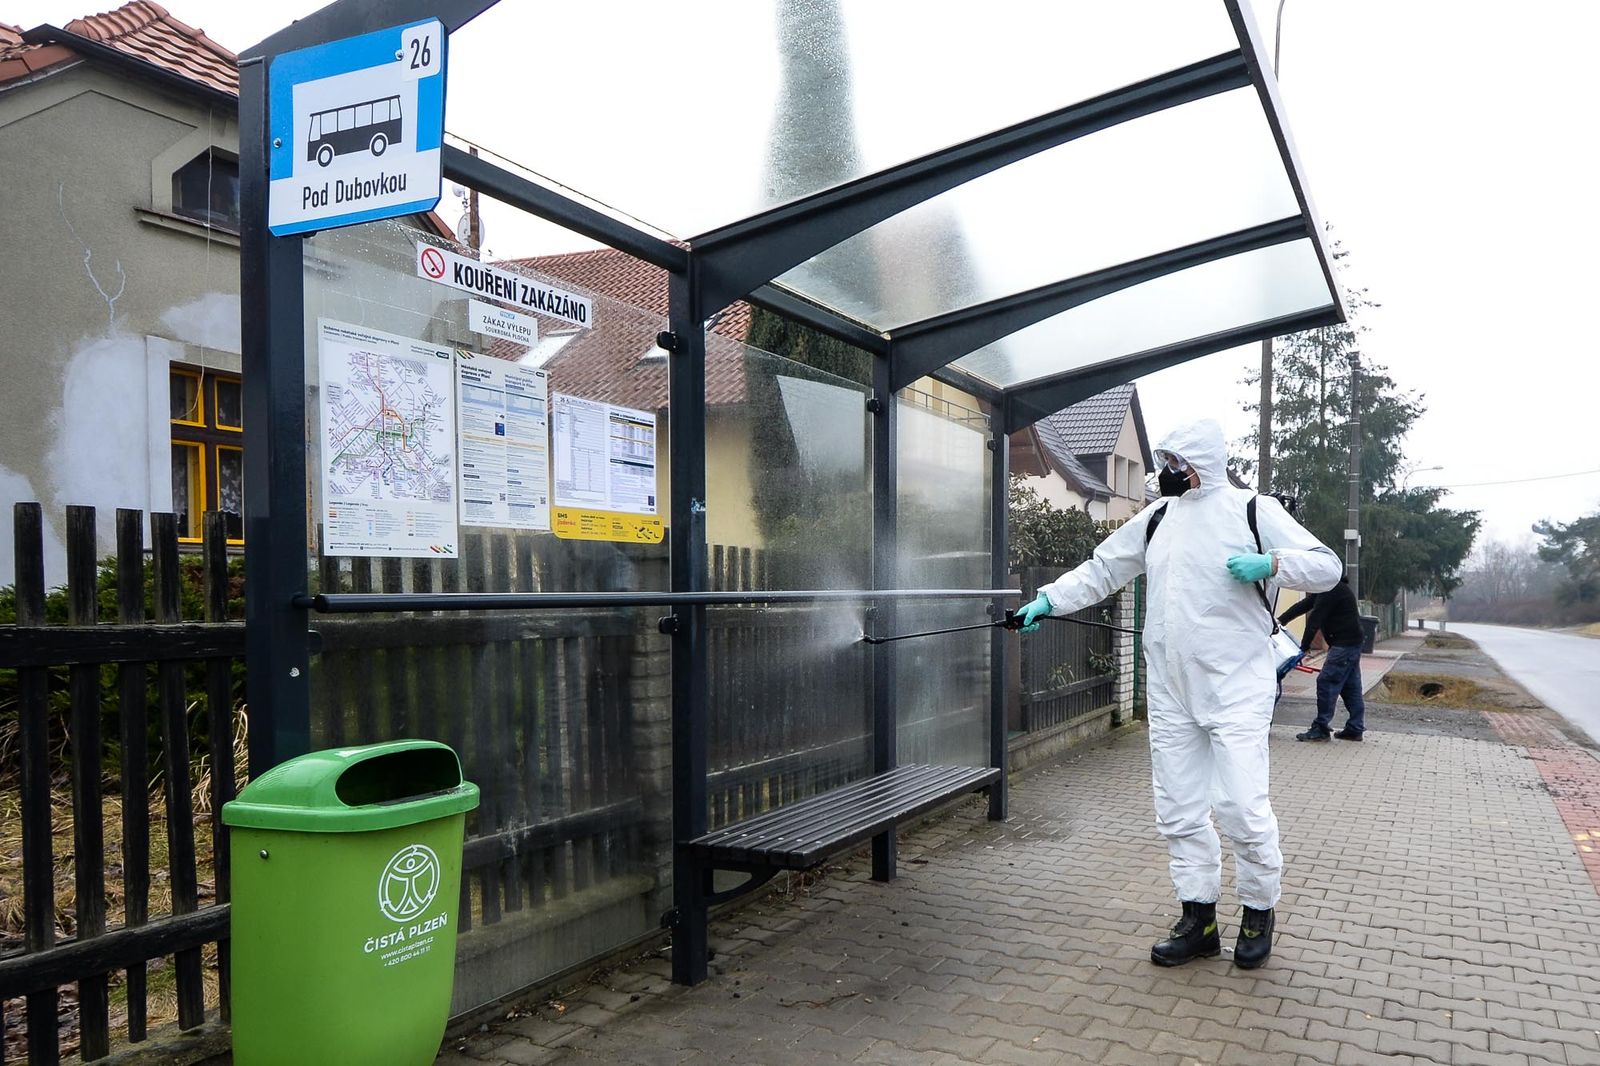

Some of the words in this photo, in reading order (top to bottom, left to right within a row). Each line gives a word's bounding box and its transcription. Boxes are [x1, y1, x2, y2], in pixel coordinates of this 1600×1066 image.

[410, 35, 431, 70] 26
[302, 182, 329, 210] Pod
[335, 172, 407, 204] Dubovkou
[453, 261, 518, 302] KOUŘENÍ
[521, 283, 587, 323] ZAKÁZÁNO
[482, 314, 506, 329] ZÁKAZ
[506, 321, 532, 336] VÝLEPU
[364, 926, 405, 953] ČISTÁ
[409, 912, 448, 938] PLZEŇ
